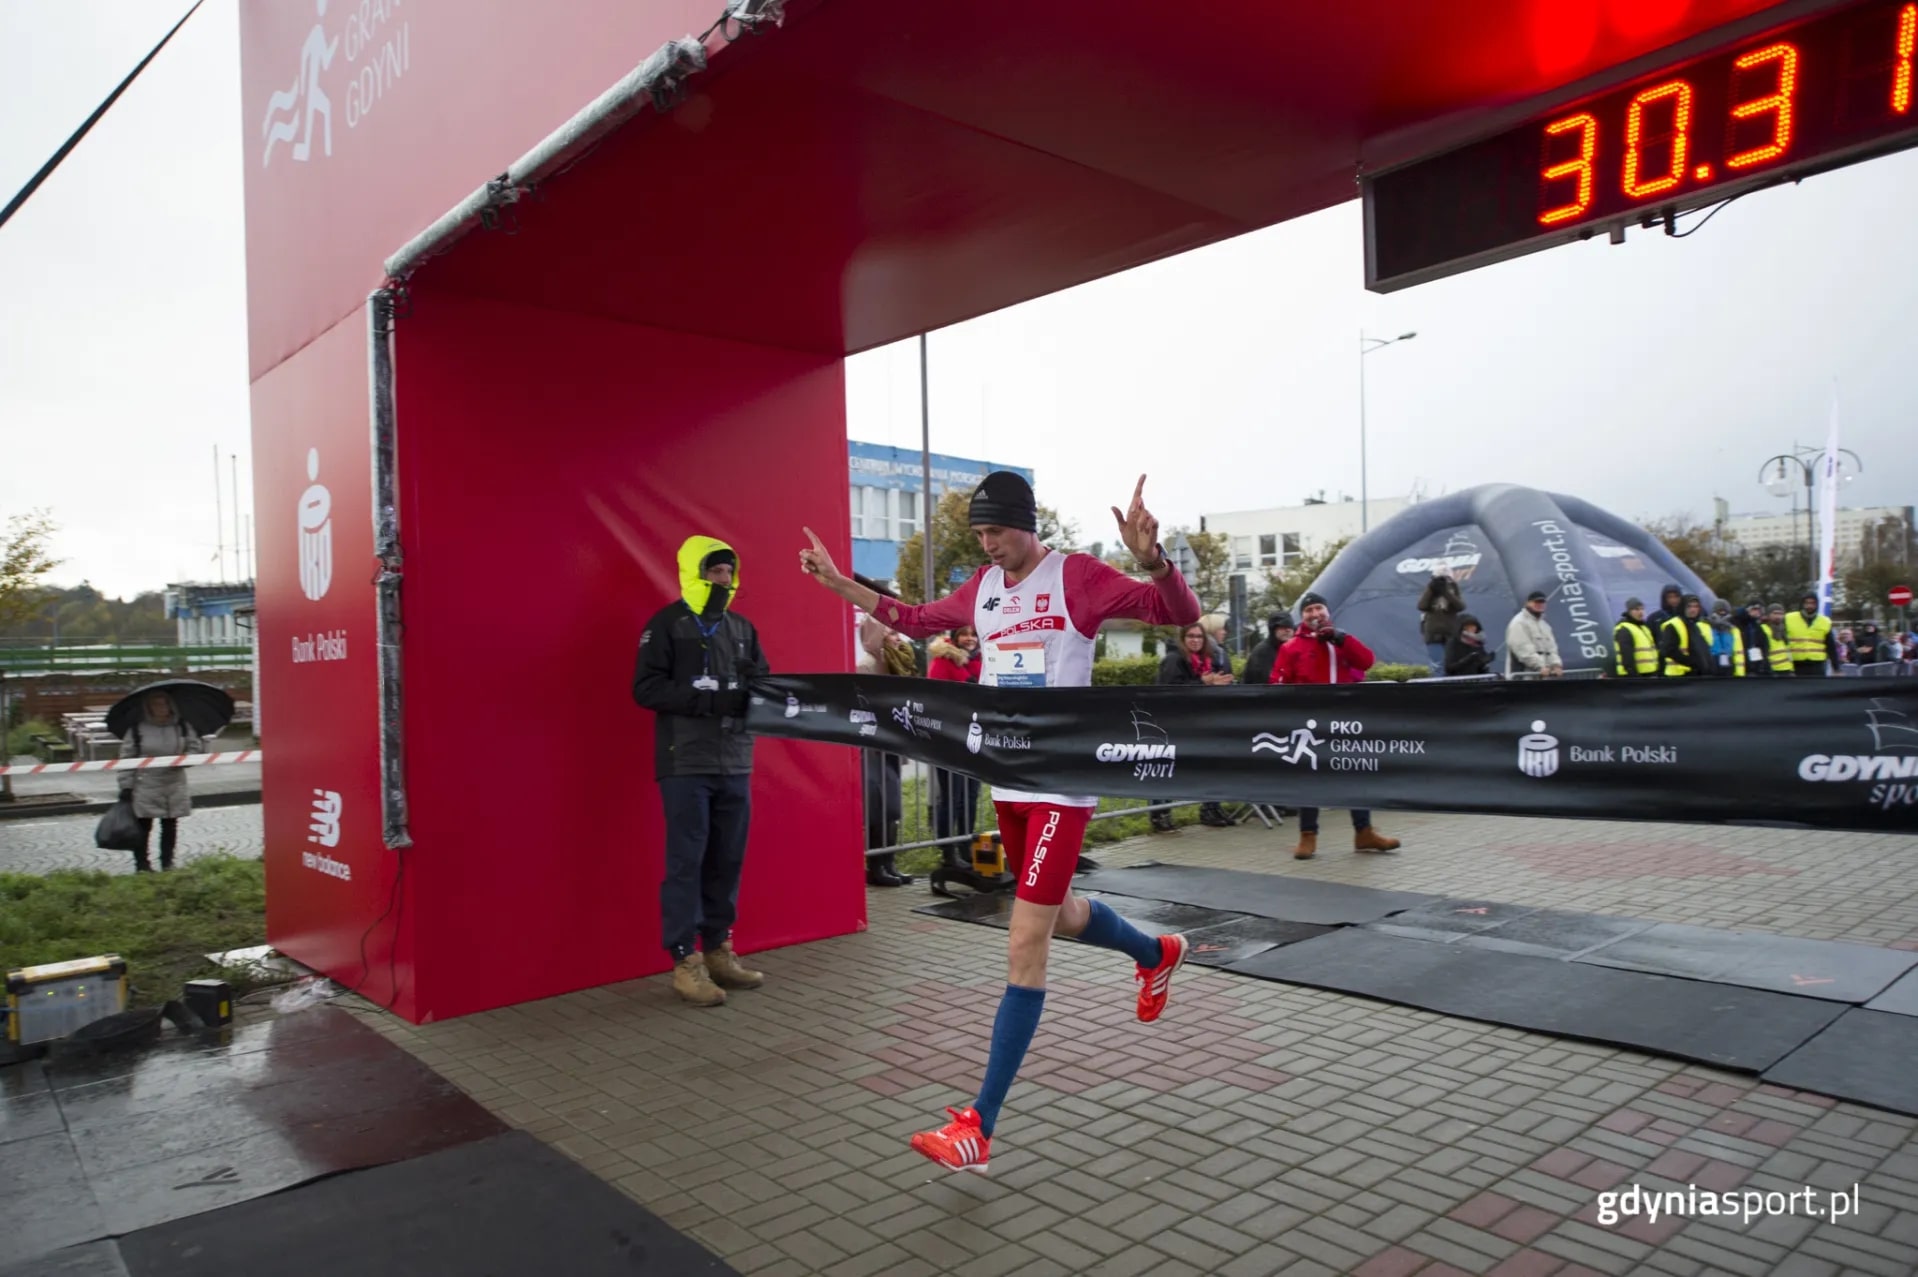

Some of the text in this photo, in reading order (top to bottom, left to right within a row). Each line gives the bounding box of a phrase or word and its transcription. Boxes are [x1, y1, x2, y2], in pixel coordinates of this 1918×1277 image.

[345, 20, 409, 128] GDYNI
[1531, 519, 1607, 659] gdyniasport.pl
[1001, 618, 1054, 637] POLSKA
[317, 629, 347, 661] Polski
[1013, 652, 1024, 668] 2
[1330, 720, 1363, 735] PKO
[984, 734, 1031, 750] Bank Polski
[1330, 739, 1425, 754] GRAND PRIX
[1095, 742, 1176, 762] GDYNIA
[1570, 745, 1677, 763] Bank Polski
[1133, 761, 1176, 781] sport
[1330, 757, 1378, 771] GDYNI
[1025, 810, 1060, 887] POLSKA
